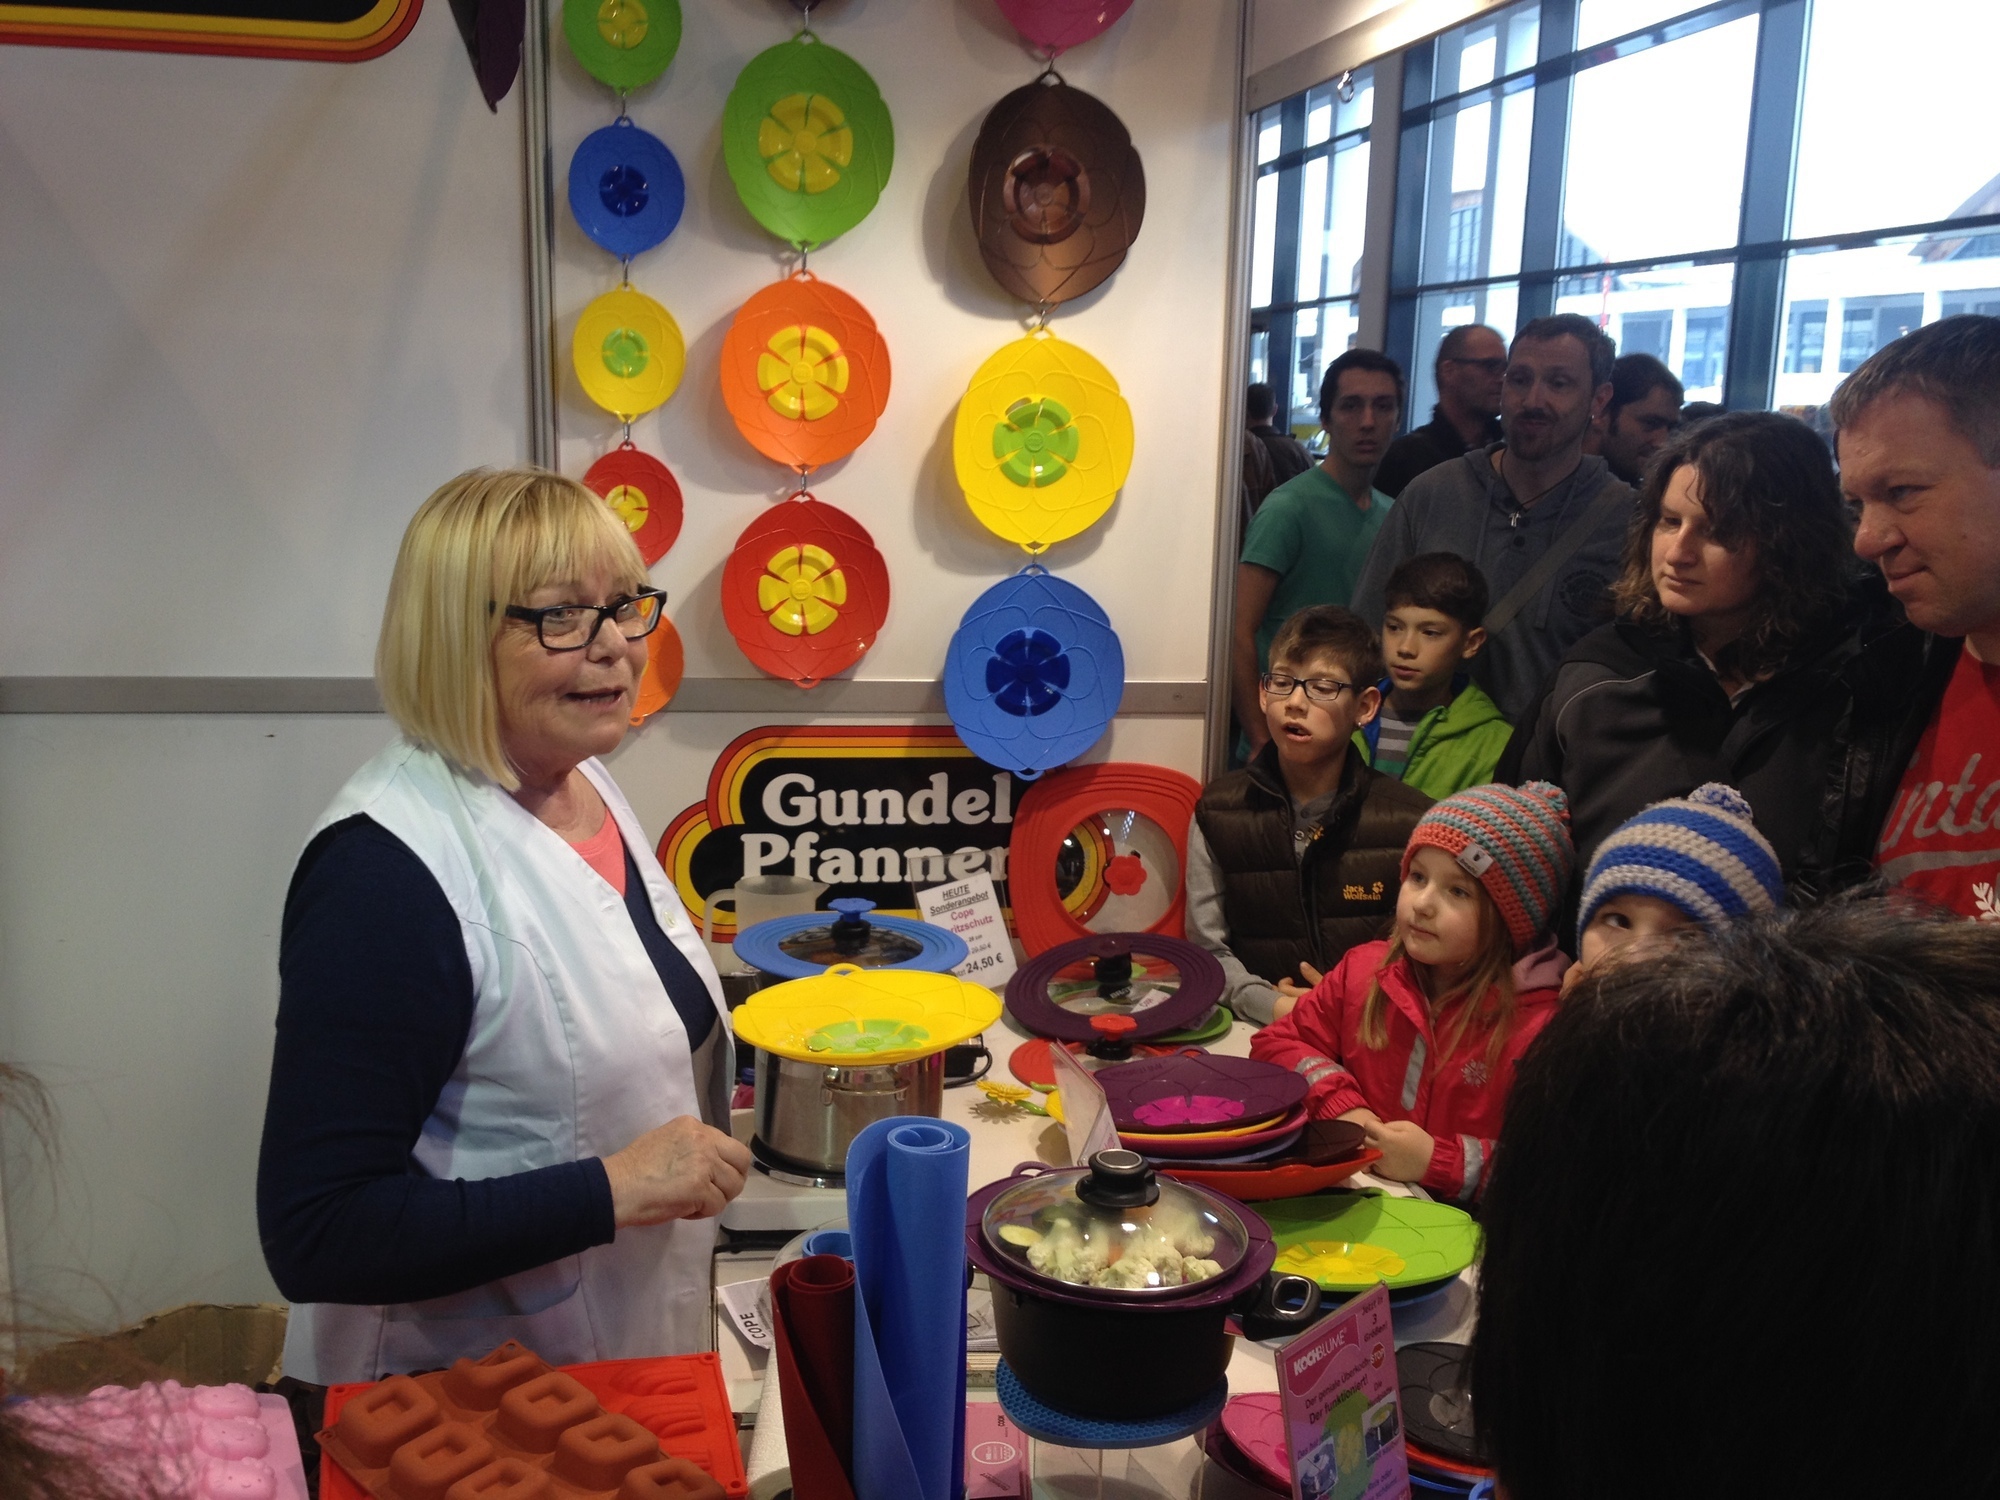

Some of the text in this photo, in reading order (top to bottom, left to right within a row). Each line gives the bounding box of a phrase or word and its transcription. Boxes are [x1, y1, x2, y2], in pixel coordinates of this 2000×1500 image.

[762, 772, 1013, 826] Gundel
[942, 884, 970, 900] HEUTE
[1342, 884, 1365, 893] Jack
[1343, 891, 1381, 900] Wolfskin
[930, 891, 989, 915] Sonderangebot
[951, 908, 974, 921] Cope
[951, 915, 994, 934] ritzschutz
[966, 956, 994, 974] 24,50
[996, 952, 1004, 963] €
[739, 1312, 766, 1339] COPE
[1372, 1313, 1377, 1325] 3
[1371, 1348, 1384, 1364] STOP
[1305, 1395, 1317, 1409] Der
[1309, 1373, 1368, 1425] Der funktioniert!
